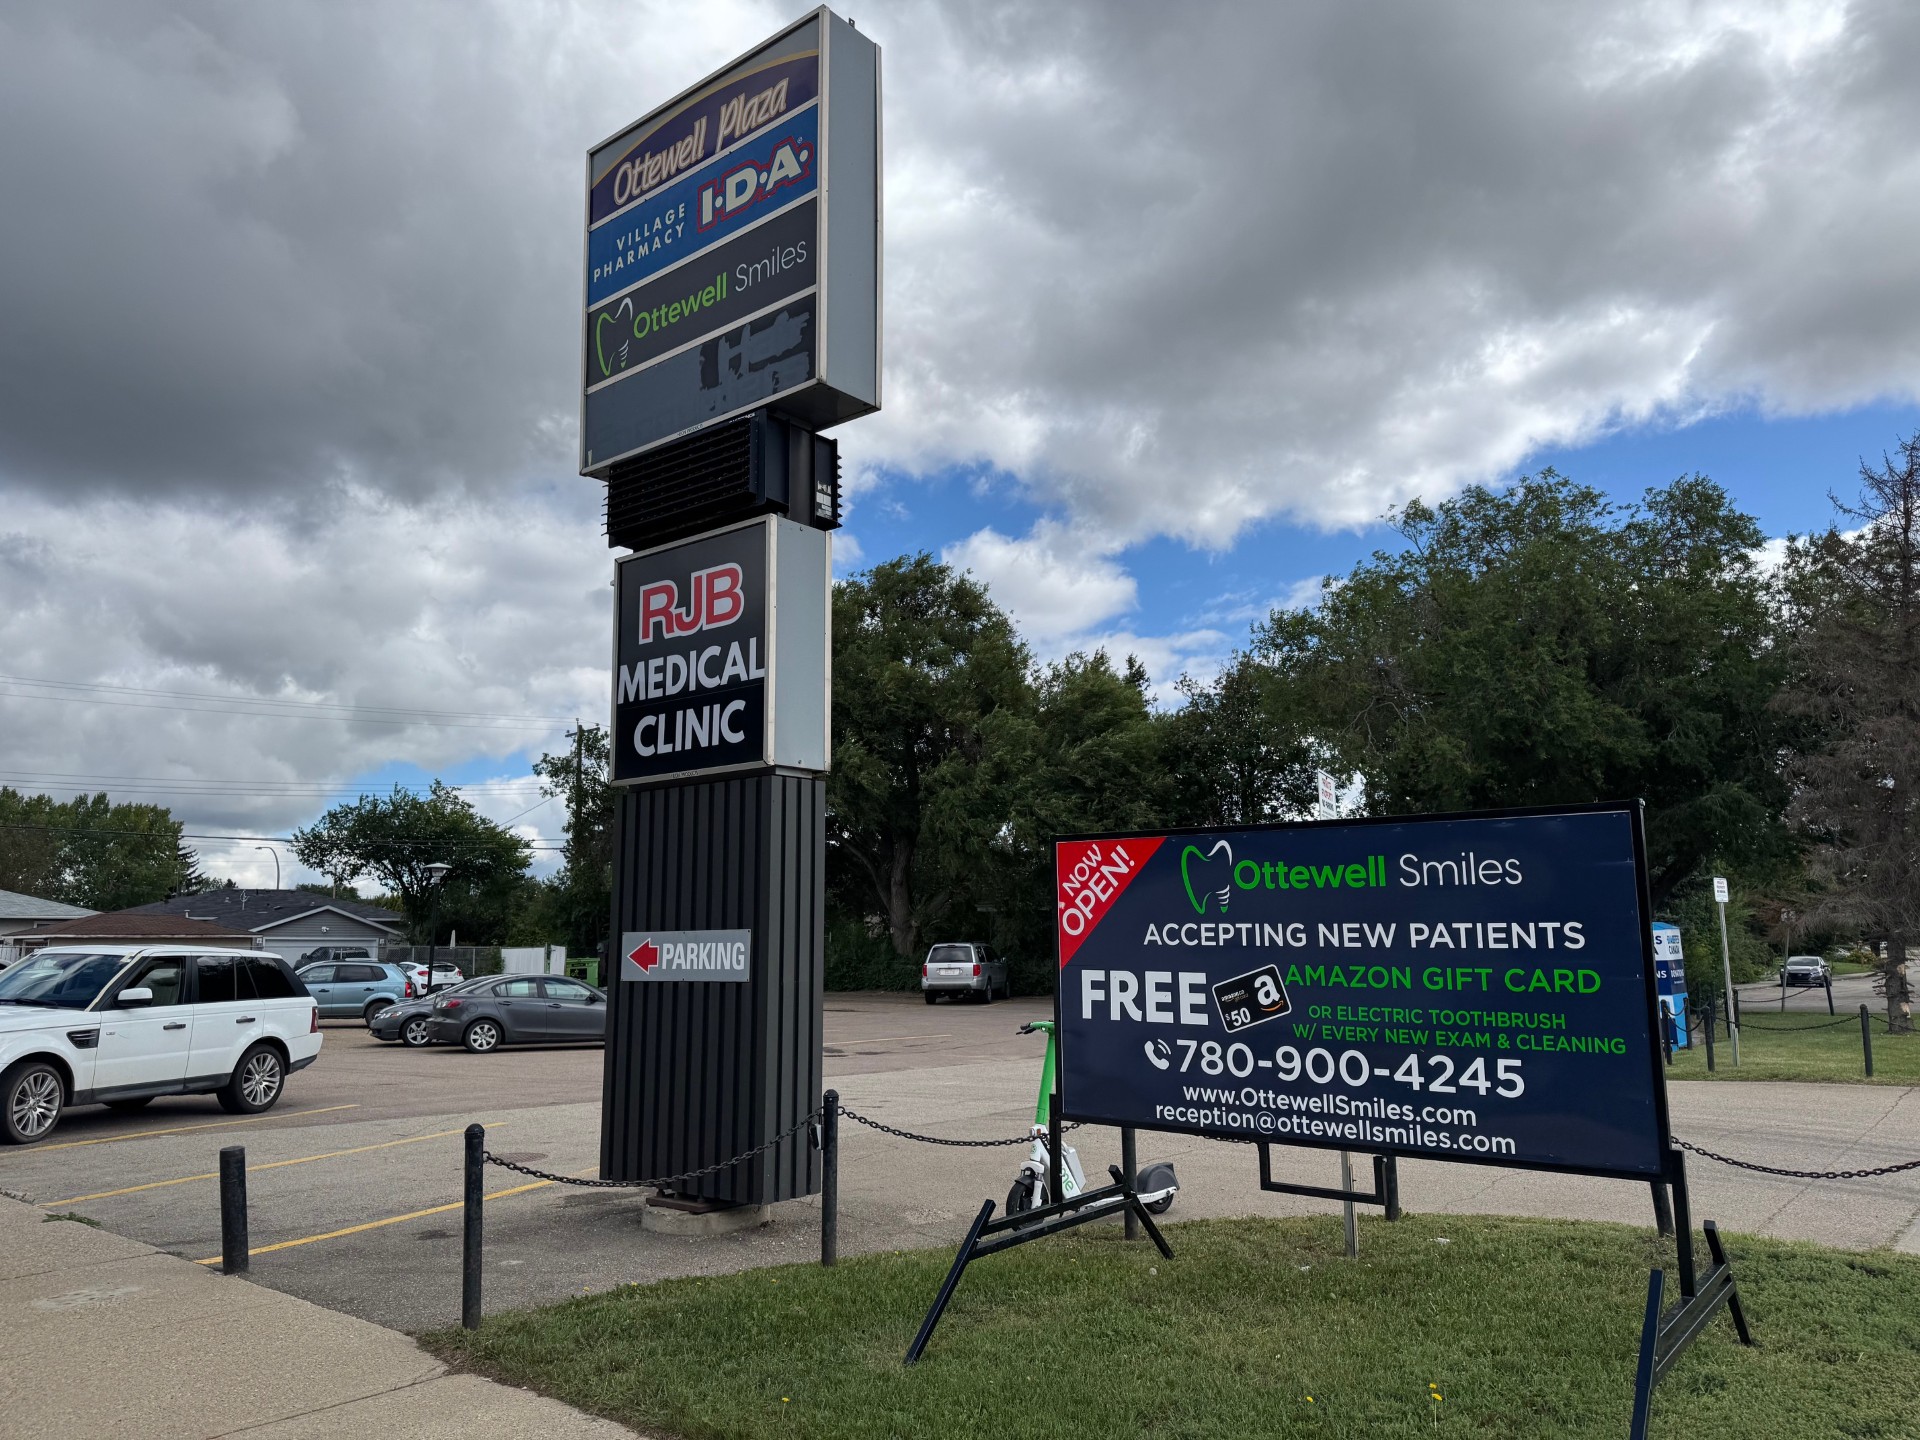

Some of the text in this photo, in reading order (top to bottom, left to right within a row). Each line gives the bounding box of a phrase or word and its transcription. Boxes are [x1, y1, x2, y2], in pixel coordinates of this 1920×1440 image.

[613, 76, 789, 206] Ottewell Plaza
[593, 222, 685, 283] PHARMACY
[616, 203, 686, 252] VILLAGE
[633, 239, 807, 339] Ottewell Smiles
[638, 562, 745, 645] RJB
[617, 636, 766, 705] MEDICAL
[633, 699, 747, 757] CLINIC
[1061, 845, 1136, 937] OPEN!
[1062, 844, 1103, 897] NOW
[1234, 851, 1523, 890] Ottewell Smiles
[661, 942, 745, 970] PARKING
[1143, 922, 1586, 950] ACCEPTING NEW PATIENTS
[1081, 969, 1209, 1026] FREE
[1285, 964, 1601, 994] AMAZON GIFT CARD
[1292, 1023, 1626, 1055] W/ EVERY NEW EXAM & CLEANING
[1308, 1006, 1566, 1030] OR ELECTRIC TOOTHBRUSH
[1175, 1039, 1526, 1098] 780-900-4245
[1155, 1102, 1516, 1156] reception@ottewellsmiles.com
[1183, 1086, 1477, 1127] www.OttewellSmiles.com
